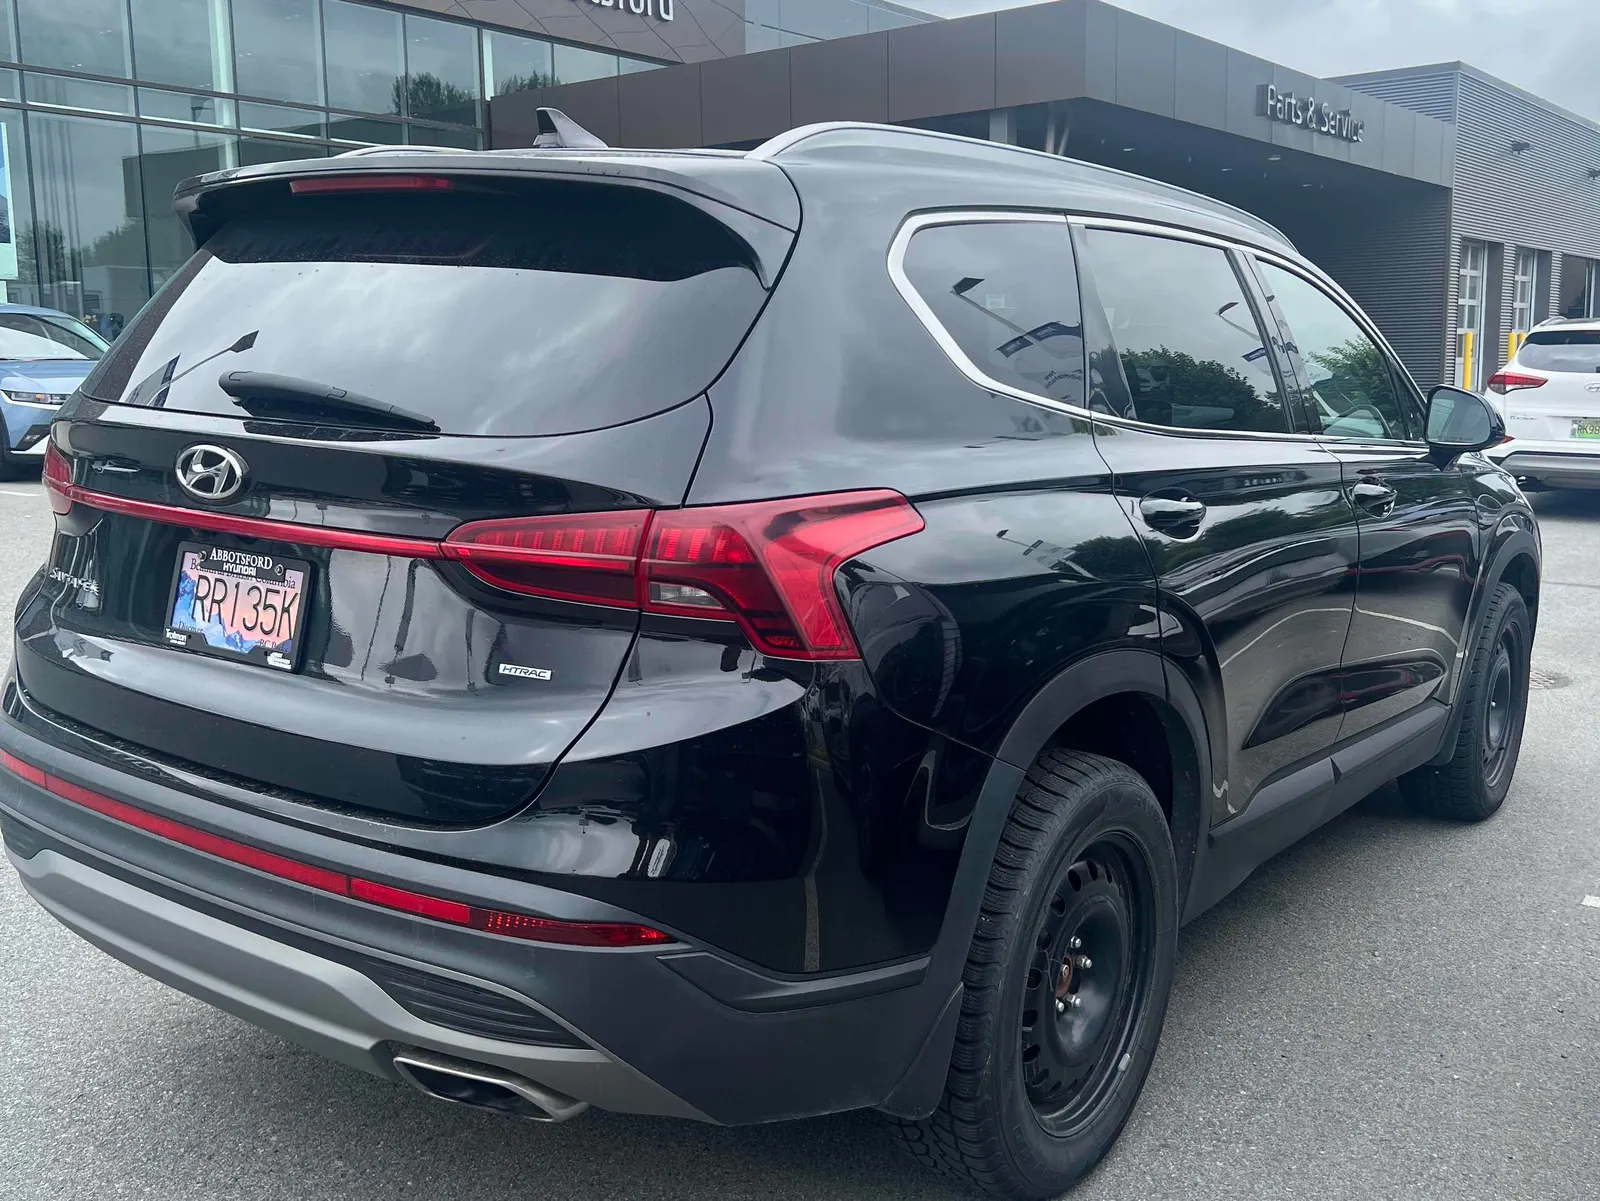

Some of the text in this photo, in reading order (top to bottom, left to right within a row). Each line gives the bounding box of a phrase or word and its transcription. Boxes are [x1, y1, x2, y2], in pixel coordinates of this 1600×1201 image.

[1266, 84, 1365, 142] Parts & Service
[210, 547, 273, 570] ABBOTSFORD
[223, 562, 257, 577] HYUNDAI
[191, 575, 299, 640] RR135K
[502, 665, 548, 678] HTRAC
